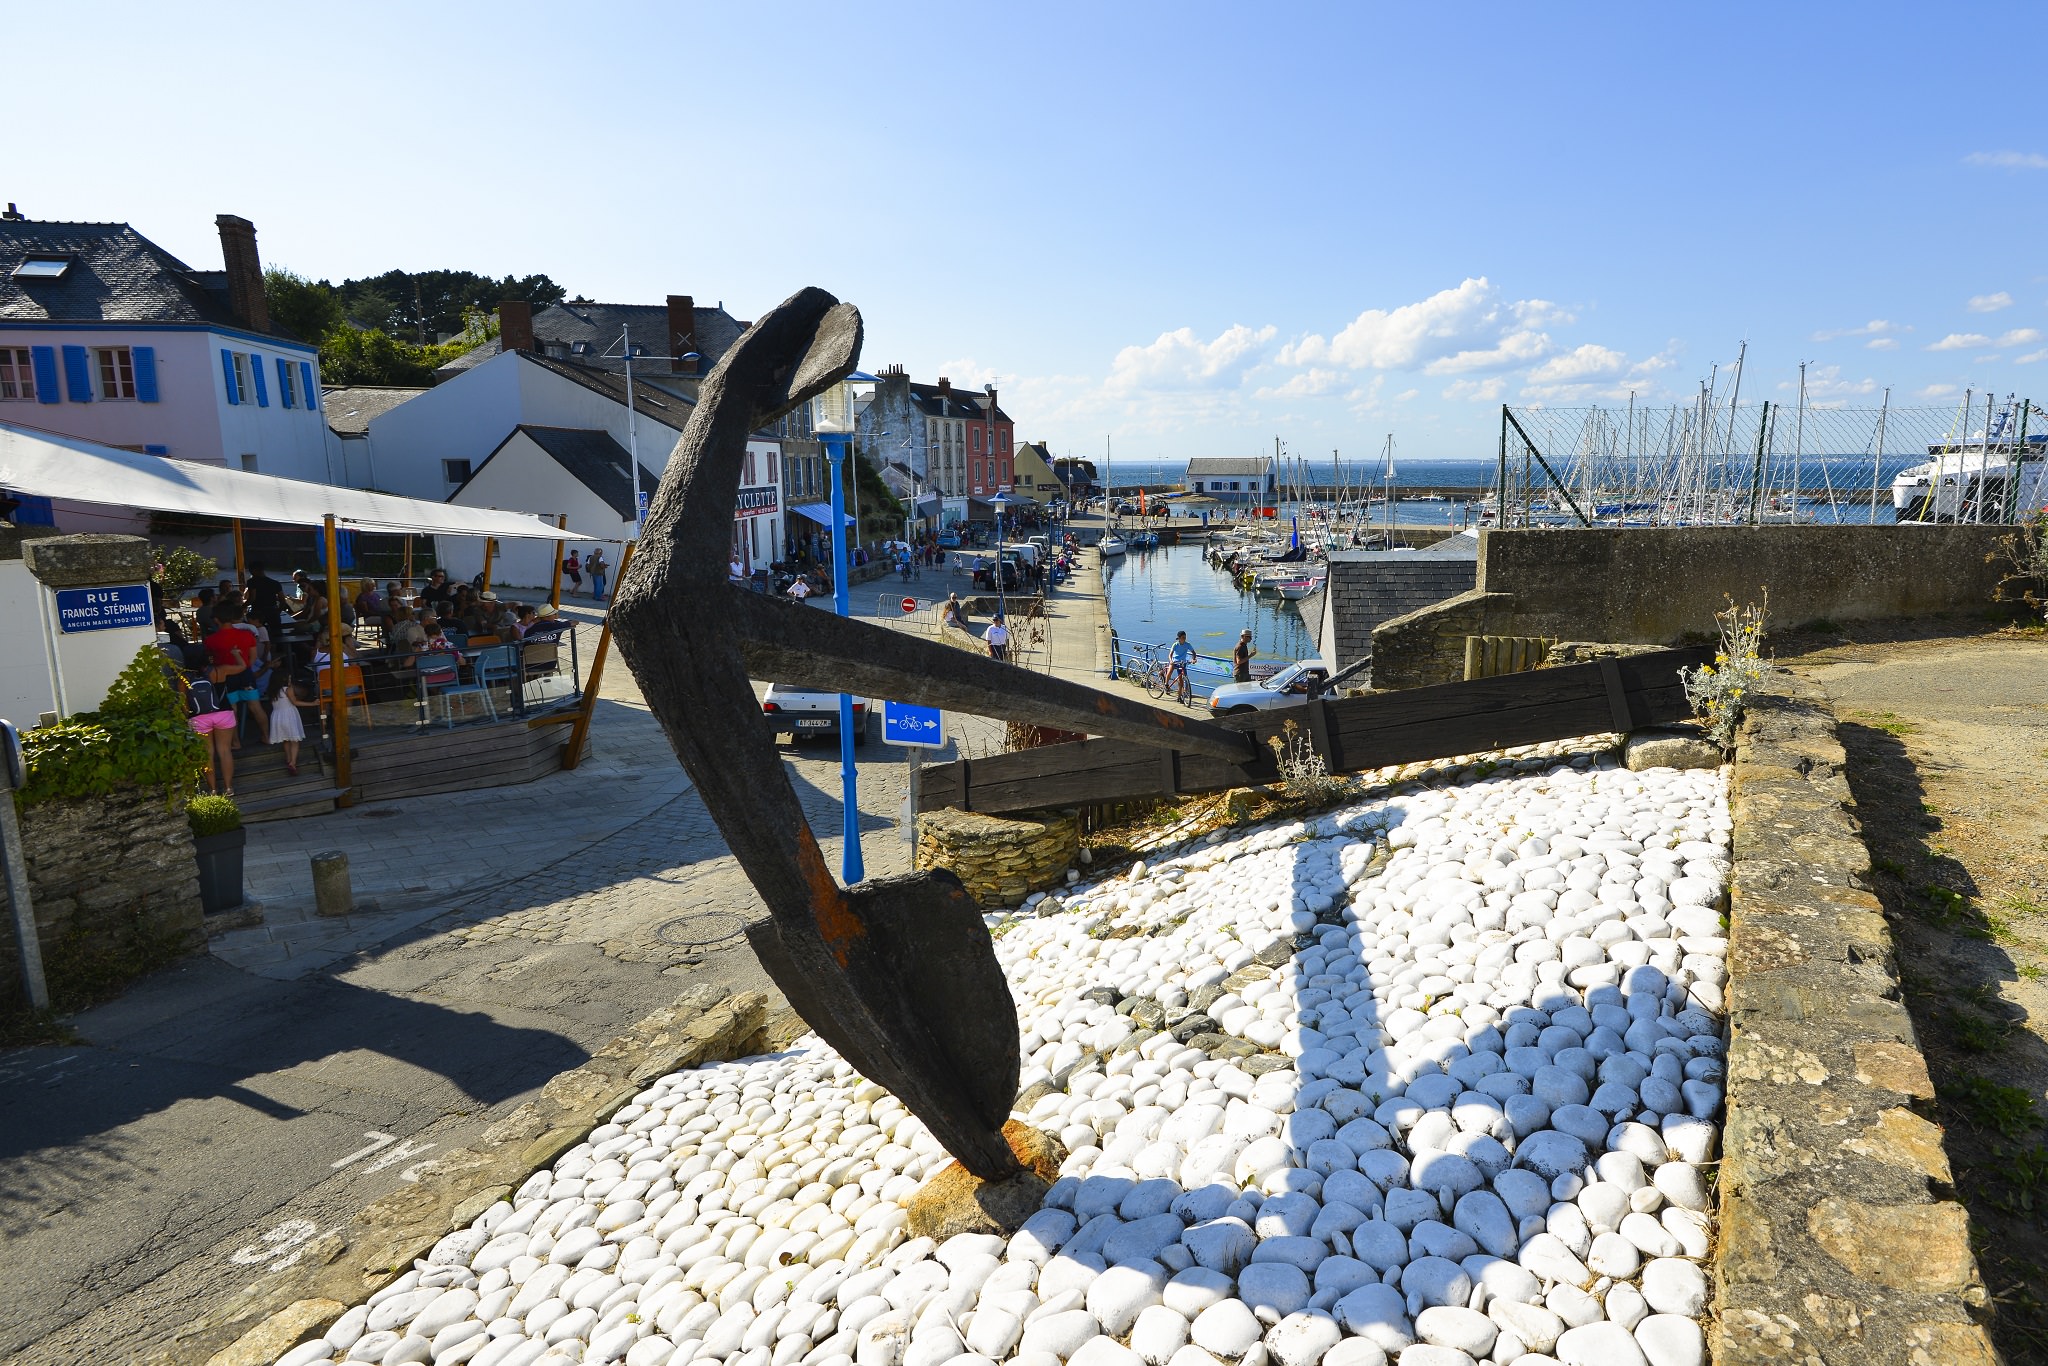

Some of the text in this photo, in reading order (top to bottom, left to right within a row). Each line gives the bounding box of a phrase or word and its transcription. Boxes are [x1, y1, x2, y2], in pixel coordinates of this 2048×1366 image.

[735, 491, 776, 509] YCLETTE
[86, 591, 120, 604] RUE
[62, 602, 146, 619] FRANCIS STÉPHANT
[67, 619, 91, 628] ANCIEN
[114, 616, 146, 624] 1902-1979
